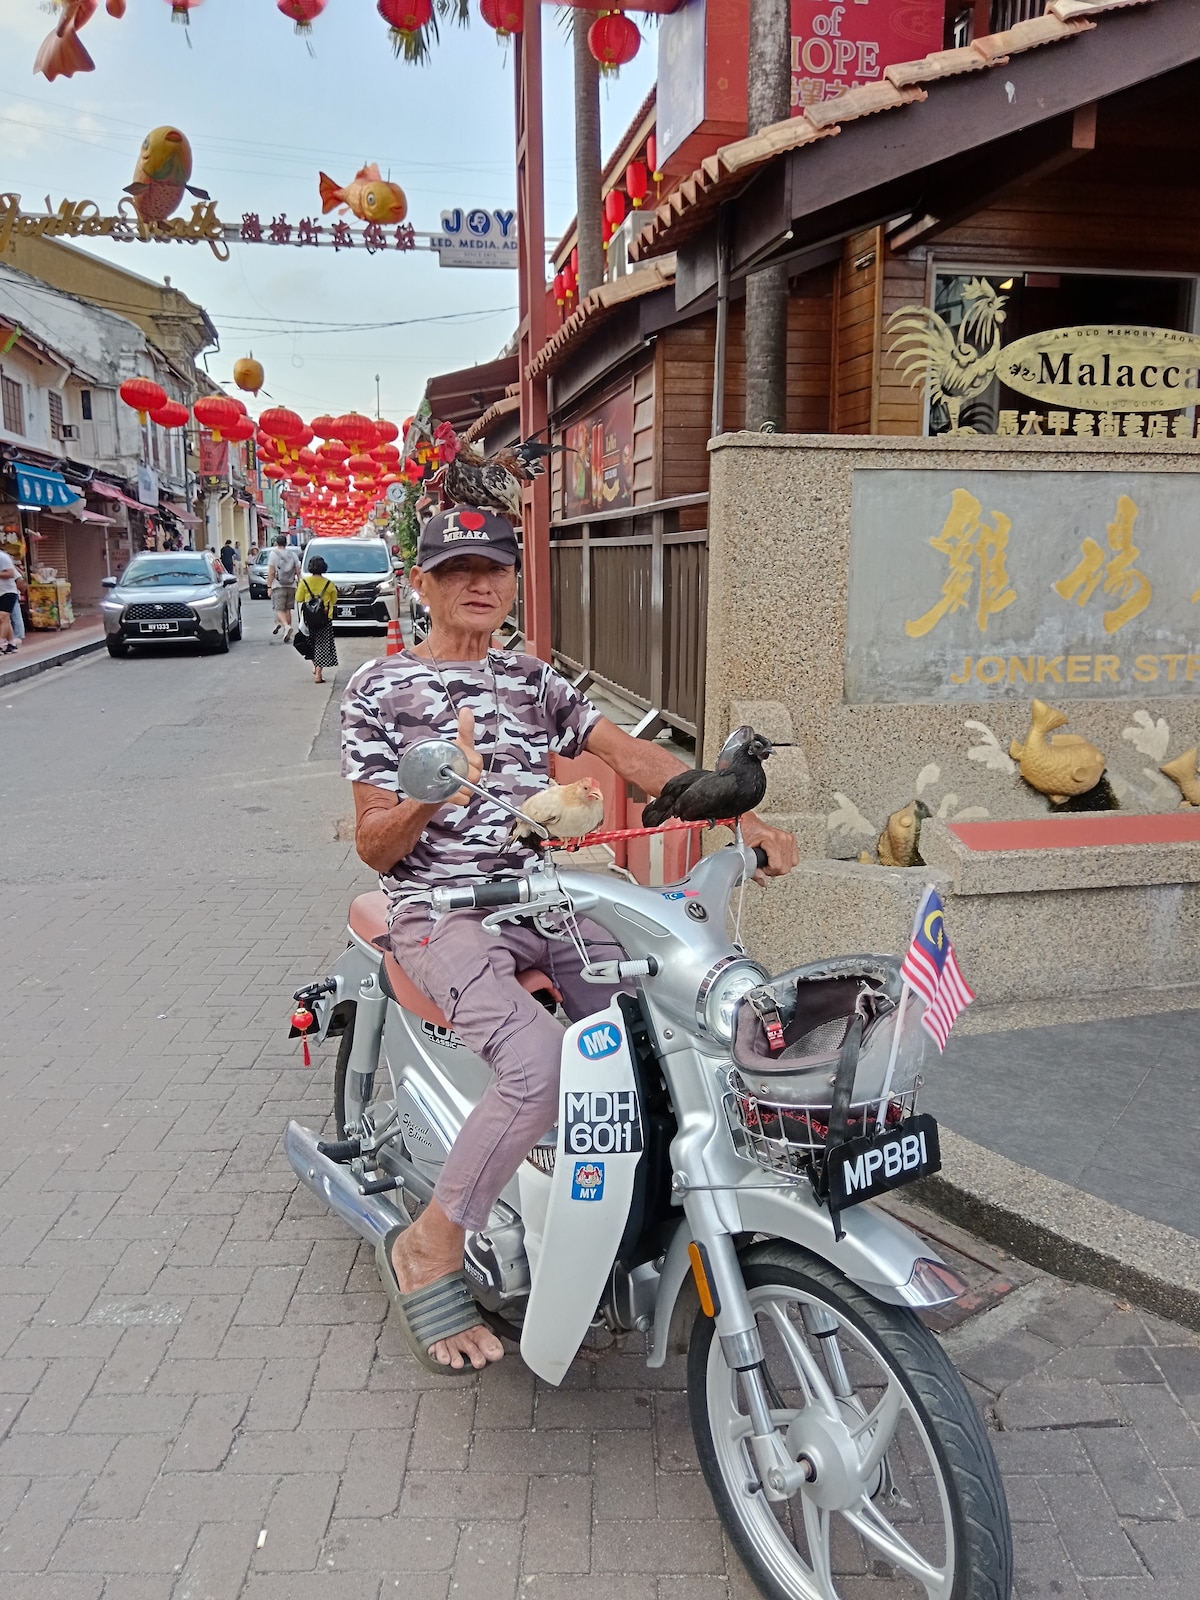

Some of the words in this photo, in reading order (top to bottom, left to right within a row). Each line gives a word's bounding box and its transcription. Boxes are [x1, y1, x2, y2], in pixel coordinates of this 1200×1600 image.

[812, 6, 846, 36] of
[791, 76, 873, 107] 望之
[441, 209, 515, 237] JOY
[459, 240, 499, 250] MEDIA.
[1107, 329, 1157, 338] MEMORY
[1164, 333, 1195, 344] FROM
[1037, 351, 1200, 389] Malacca
[1133, 399, 1165, 408] GONG
[443, 511, 461, 534] I
[443, 530, 491, 543] MELAKA
[950, 655, 1121, 685] JONKER
[428, 1036, 458, 1050] CLASSIC
[582, 1026, 617, 1056] MK
[567, 1092, 636, 1124] MDH
[402, 1113, 430, 1136] Special
[408, 1127, 433, 1148] Edition
[570, 1121, 632, 1153] 6011
[579, 1188, 597, 1199] MY
